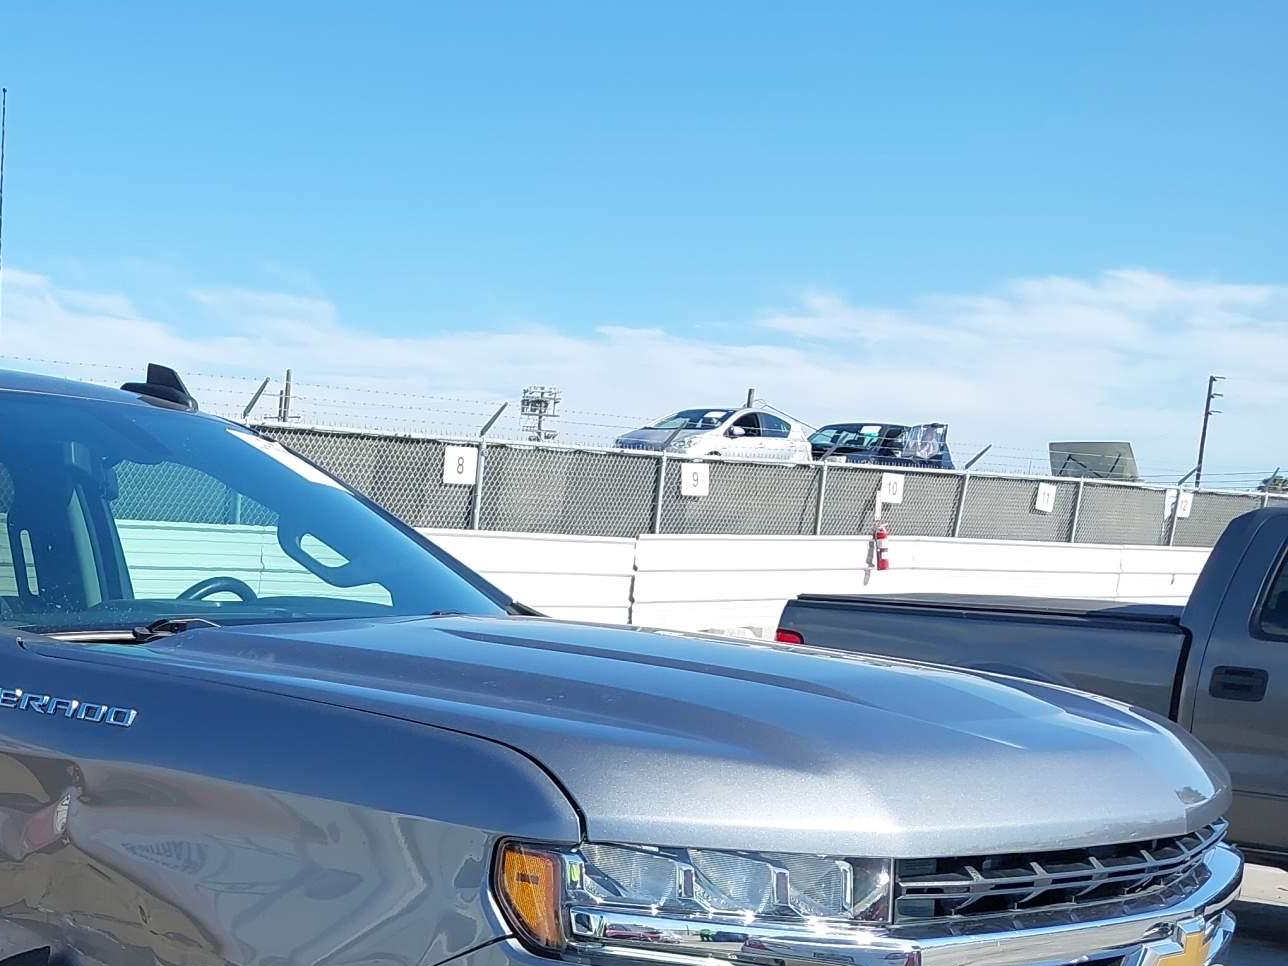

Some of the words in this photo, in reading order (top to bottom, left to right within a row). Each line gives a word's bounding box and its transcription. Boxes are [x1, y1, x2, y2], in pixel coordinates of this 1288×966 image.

[456, 456, 464, 474] 8
[692, 471, 699, 488] 9
[887, 481, 898, 496] 10
[1042, 491, 1050, 505] 11
